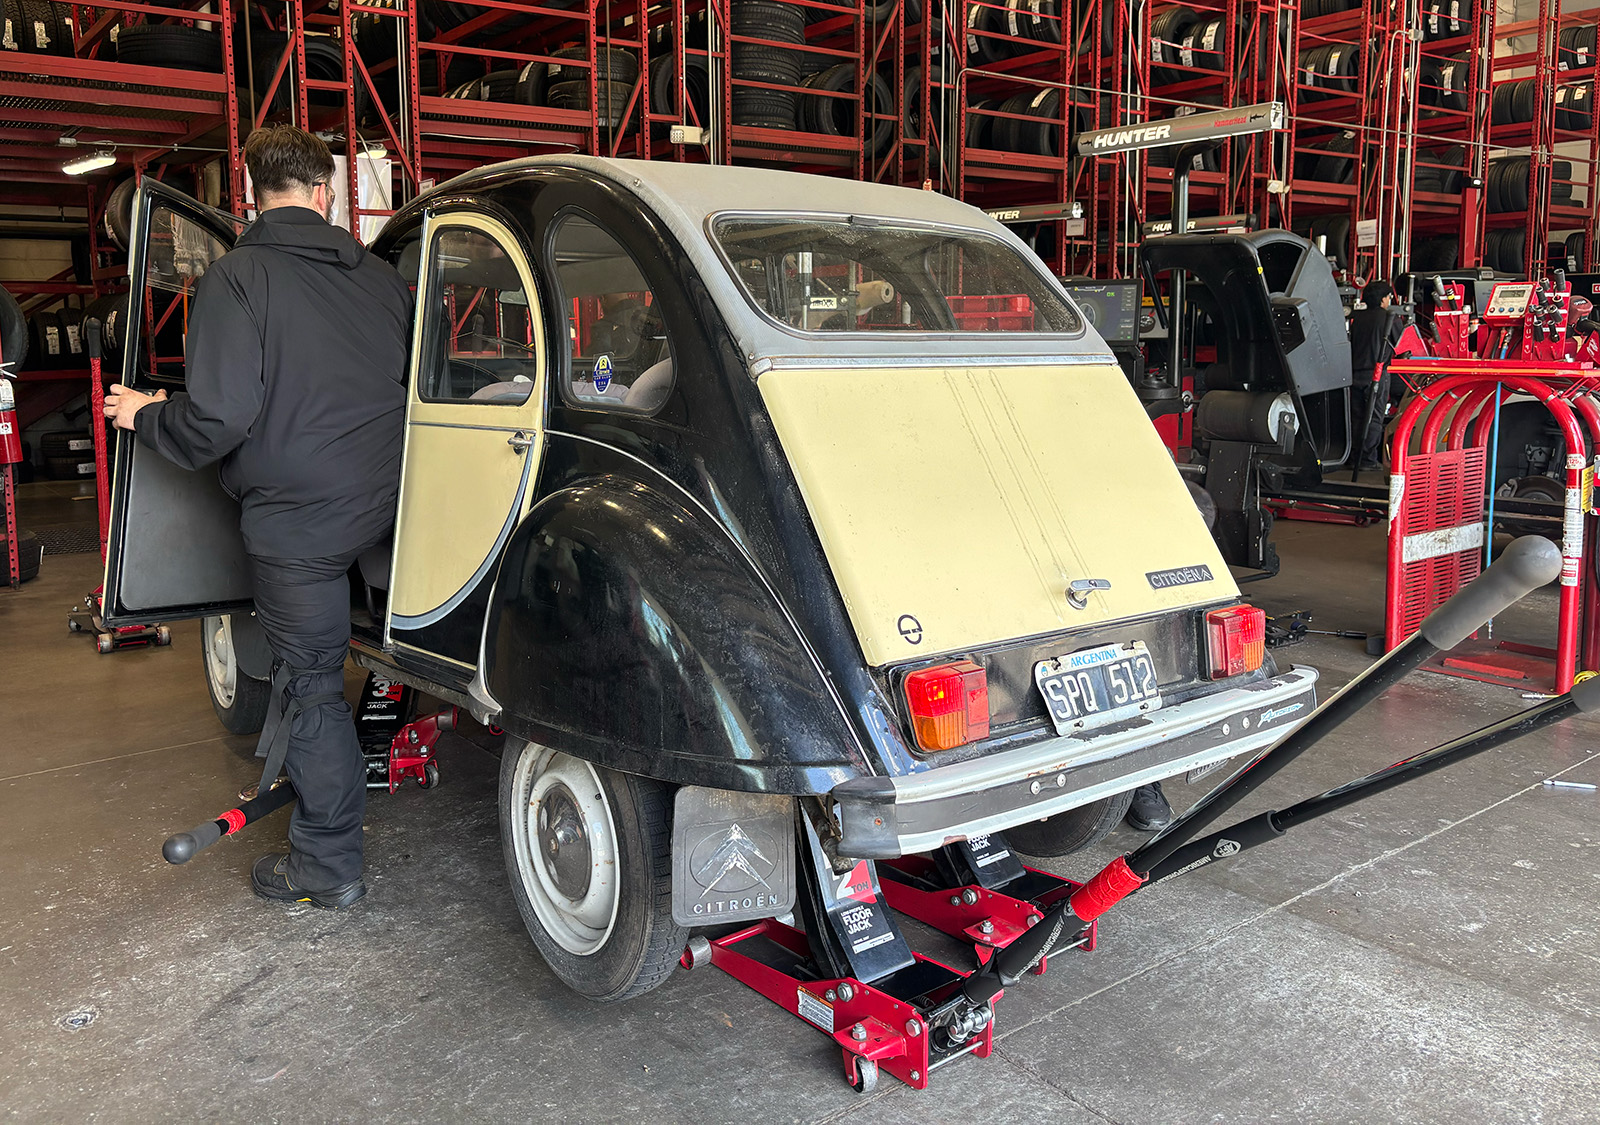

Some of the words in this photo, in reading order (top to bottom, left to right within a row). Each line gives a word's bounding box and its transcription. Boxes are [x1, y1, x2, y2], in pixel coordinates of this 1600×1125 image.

[1093, 124, 1171, 149] HUNTER
[1152, 221, 1196, 232] HUNR
[1150, 568, 1200, 588] CITROËN
[1070, 648, 1118, 668] ARGENTINA
[1044, 671, 1100, 720] SPQ
[1108, 656, 1158, 705] 512
[971, 838, 991, 852] JACK
[851, 881, 869, 894] TON
[693, 892, 778, 914] CITROËN
[842, 908, 874, 926] FLOOR
[848, 918, 873, 935] JACK
